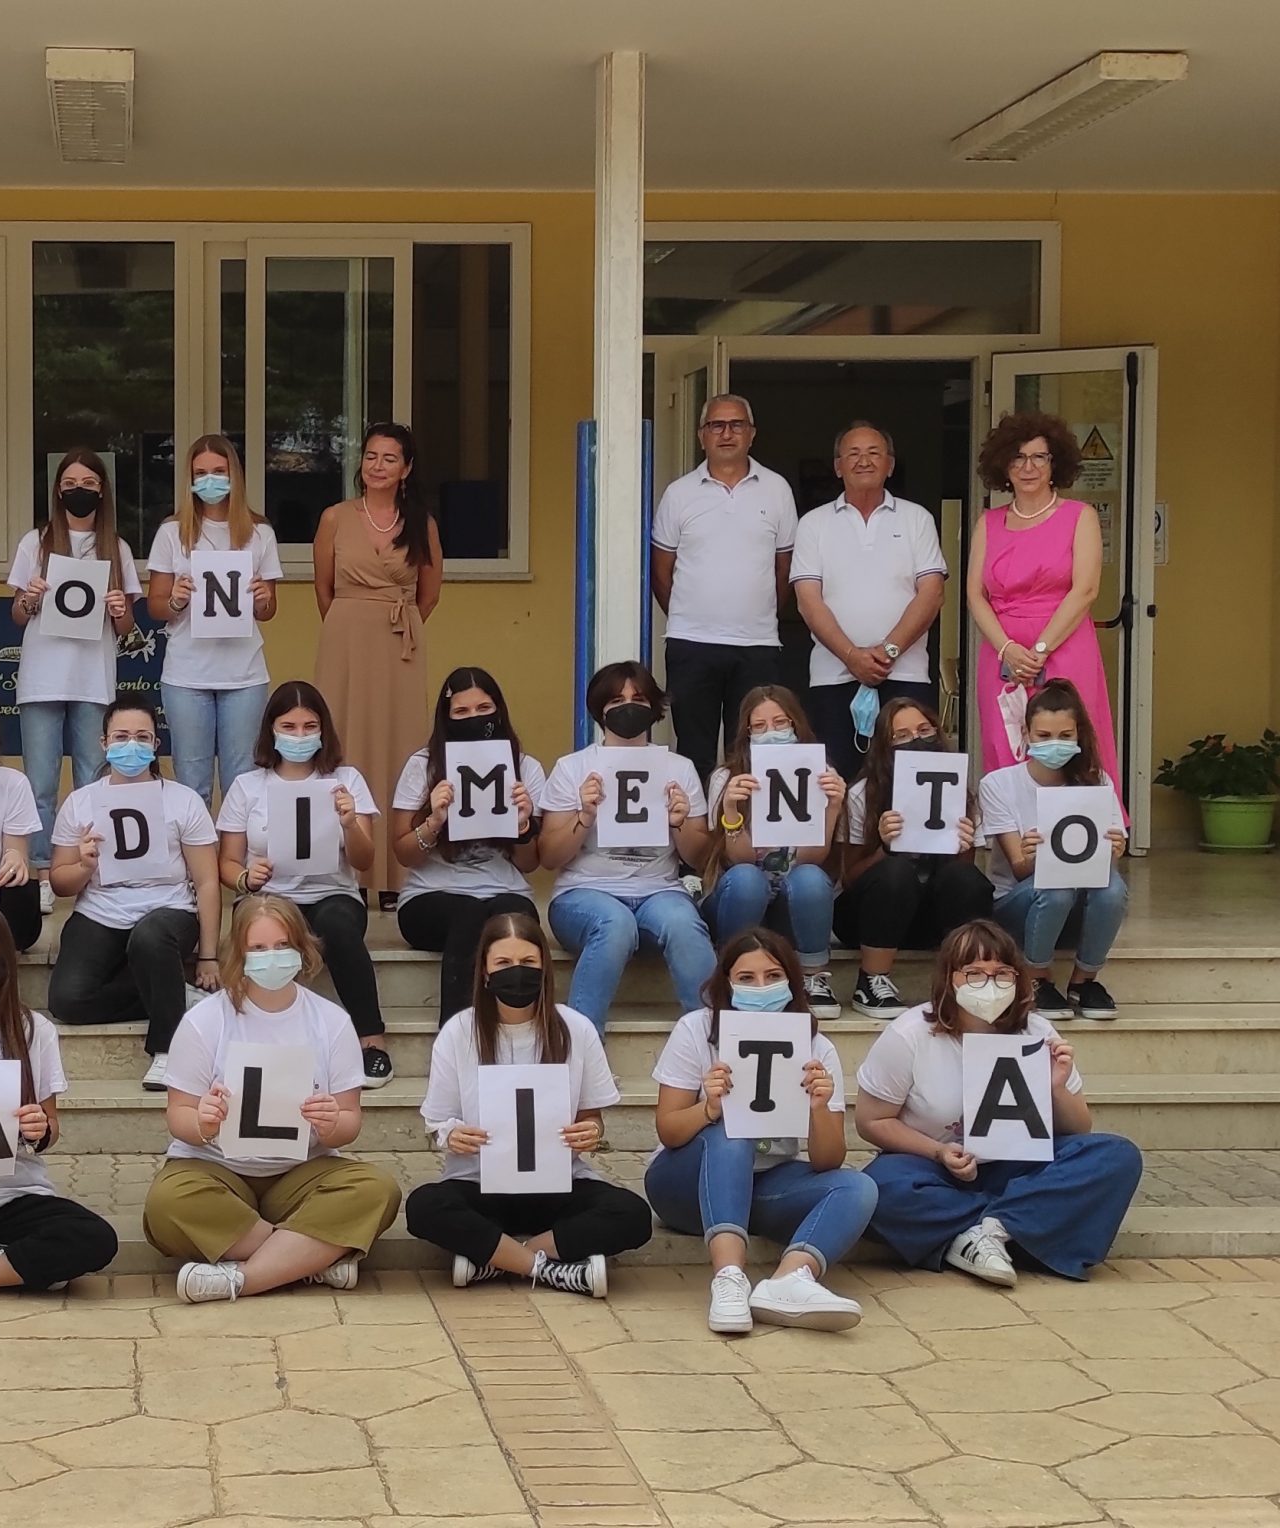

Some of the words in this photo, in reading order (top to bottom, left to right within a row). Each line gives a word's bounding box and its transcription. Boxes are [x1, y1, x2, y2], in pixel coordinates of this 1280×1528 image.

[55, 580, 95, 618] O
[203, 571, 241, 617] N
[116, 675, 150, 691] ento
[109, 809, 150, 860] D
[296, 797, 311, 860] I
[457, 764, 508, 817] M
[615, 771, 649, 823] E
[766, 768, 811, 822] N
[916, 772, 958, 830] T
[1051, 815, 1098, 863] O
[239, 1067, 299, 1140] L
[516, 1089, 535, 1172] I
[739, 1041, 793, 1112] T
